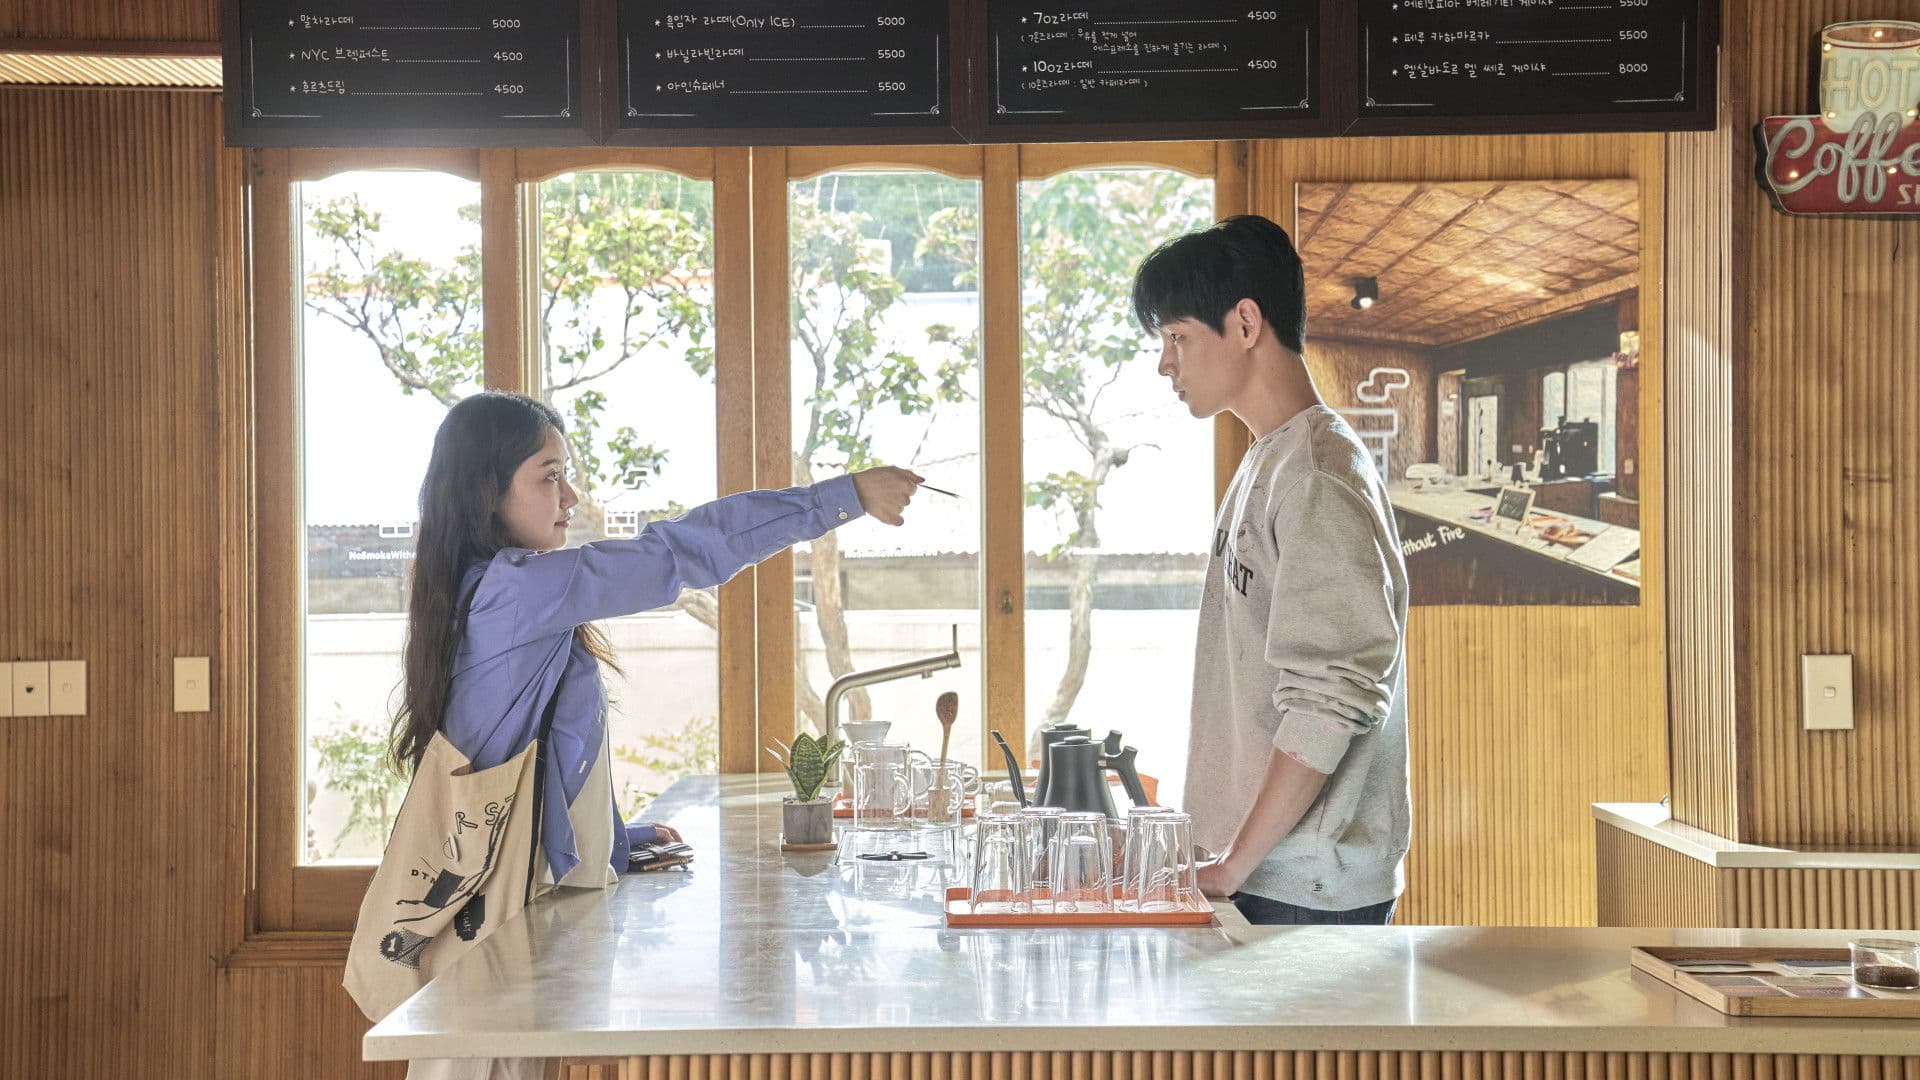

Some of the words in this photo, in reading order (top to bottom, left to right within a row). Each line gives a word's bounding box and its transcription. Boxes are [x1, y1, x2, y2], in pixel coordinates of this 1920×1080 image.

[1248, 11, 1276, 20] 4500
[493, 19, 520, 28] 5000
[667, 15, 697, 29] 흑임자
[878, 17, 905, 25] 5000
[1405, 32, 1424, 43] 페루
[1620, 31, 1647, 40] 5500
[302, 49, 329, 60] NYC
[494, 52, 522, 60] 4500
[878, 50, 905, 58] 5500
[1034, 61, 1092, 73] 10oz라떼
[1248, 60, 1276, 69] 4500
[1465, 64, 1477, 77] 엘
[1619, 64, 1647, 73] 8000
[494, 85, 523, 93] 4500
[668, 79, 724, 92] 아인슈페너
[879, 82, 905, 90] 5500
[1822, 60, 1919, 109] HOT
[1401, 532, 1437, 556] ithout
[1437, 525, 1465, 544] Fire
